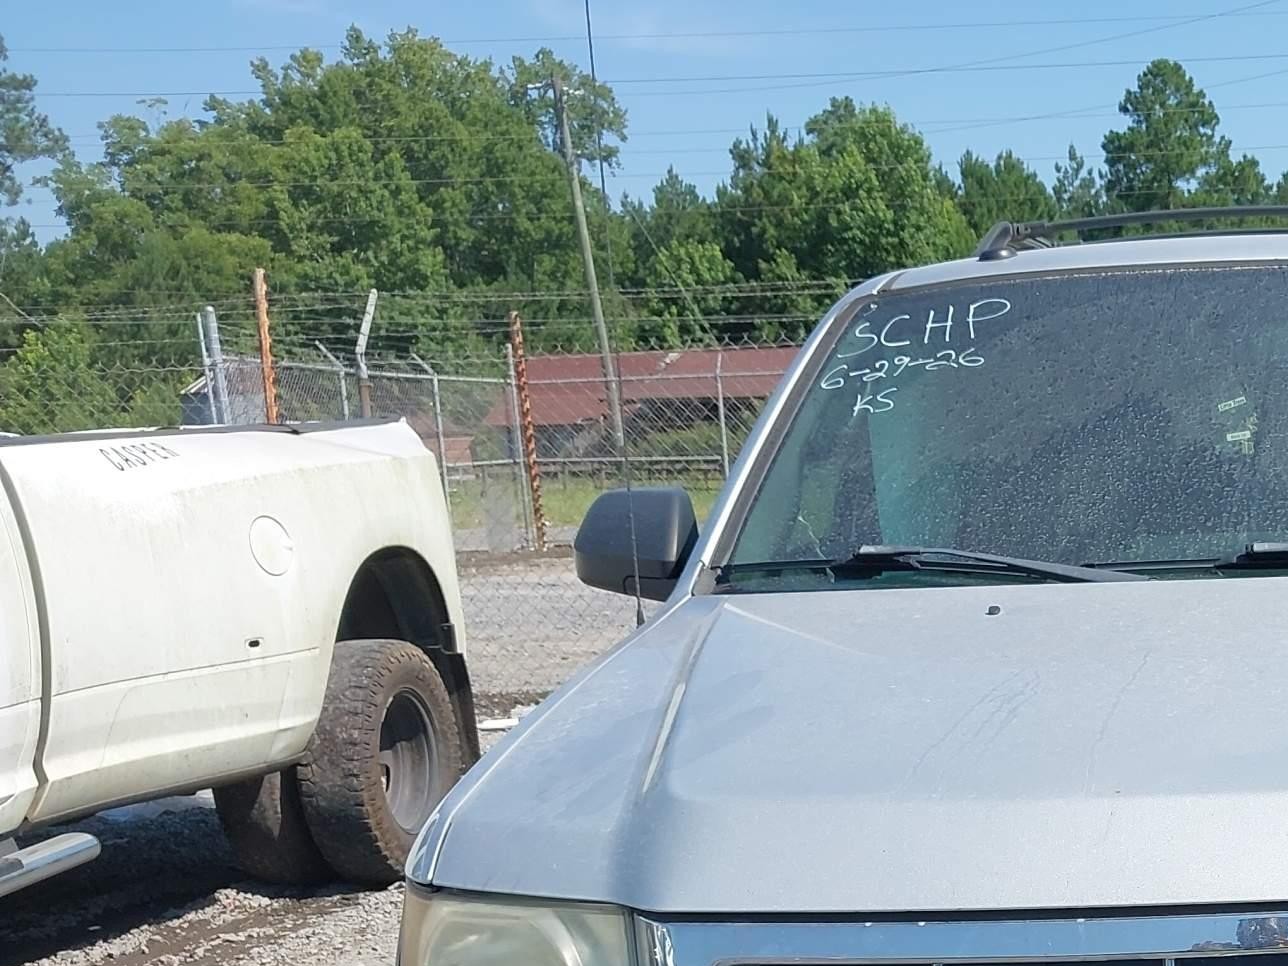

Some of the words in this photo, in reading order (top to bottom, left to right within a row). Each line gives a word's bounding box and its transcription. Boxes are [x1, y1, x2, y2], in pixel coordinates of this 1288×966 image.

[820, 347, 985, 390] 6-29-26
[853, 387, 898, 417] KS
[98, 441, 181, 471] CASPER
